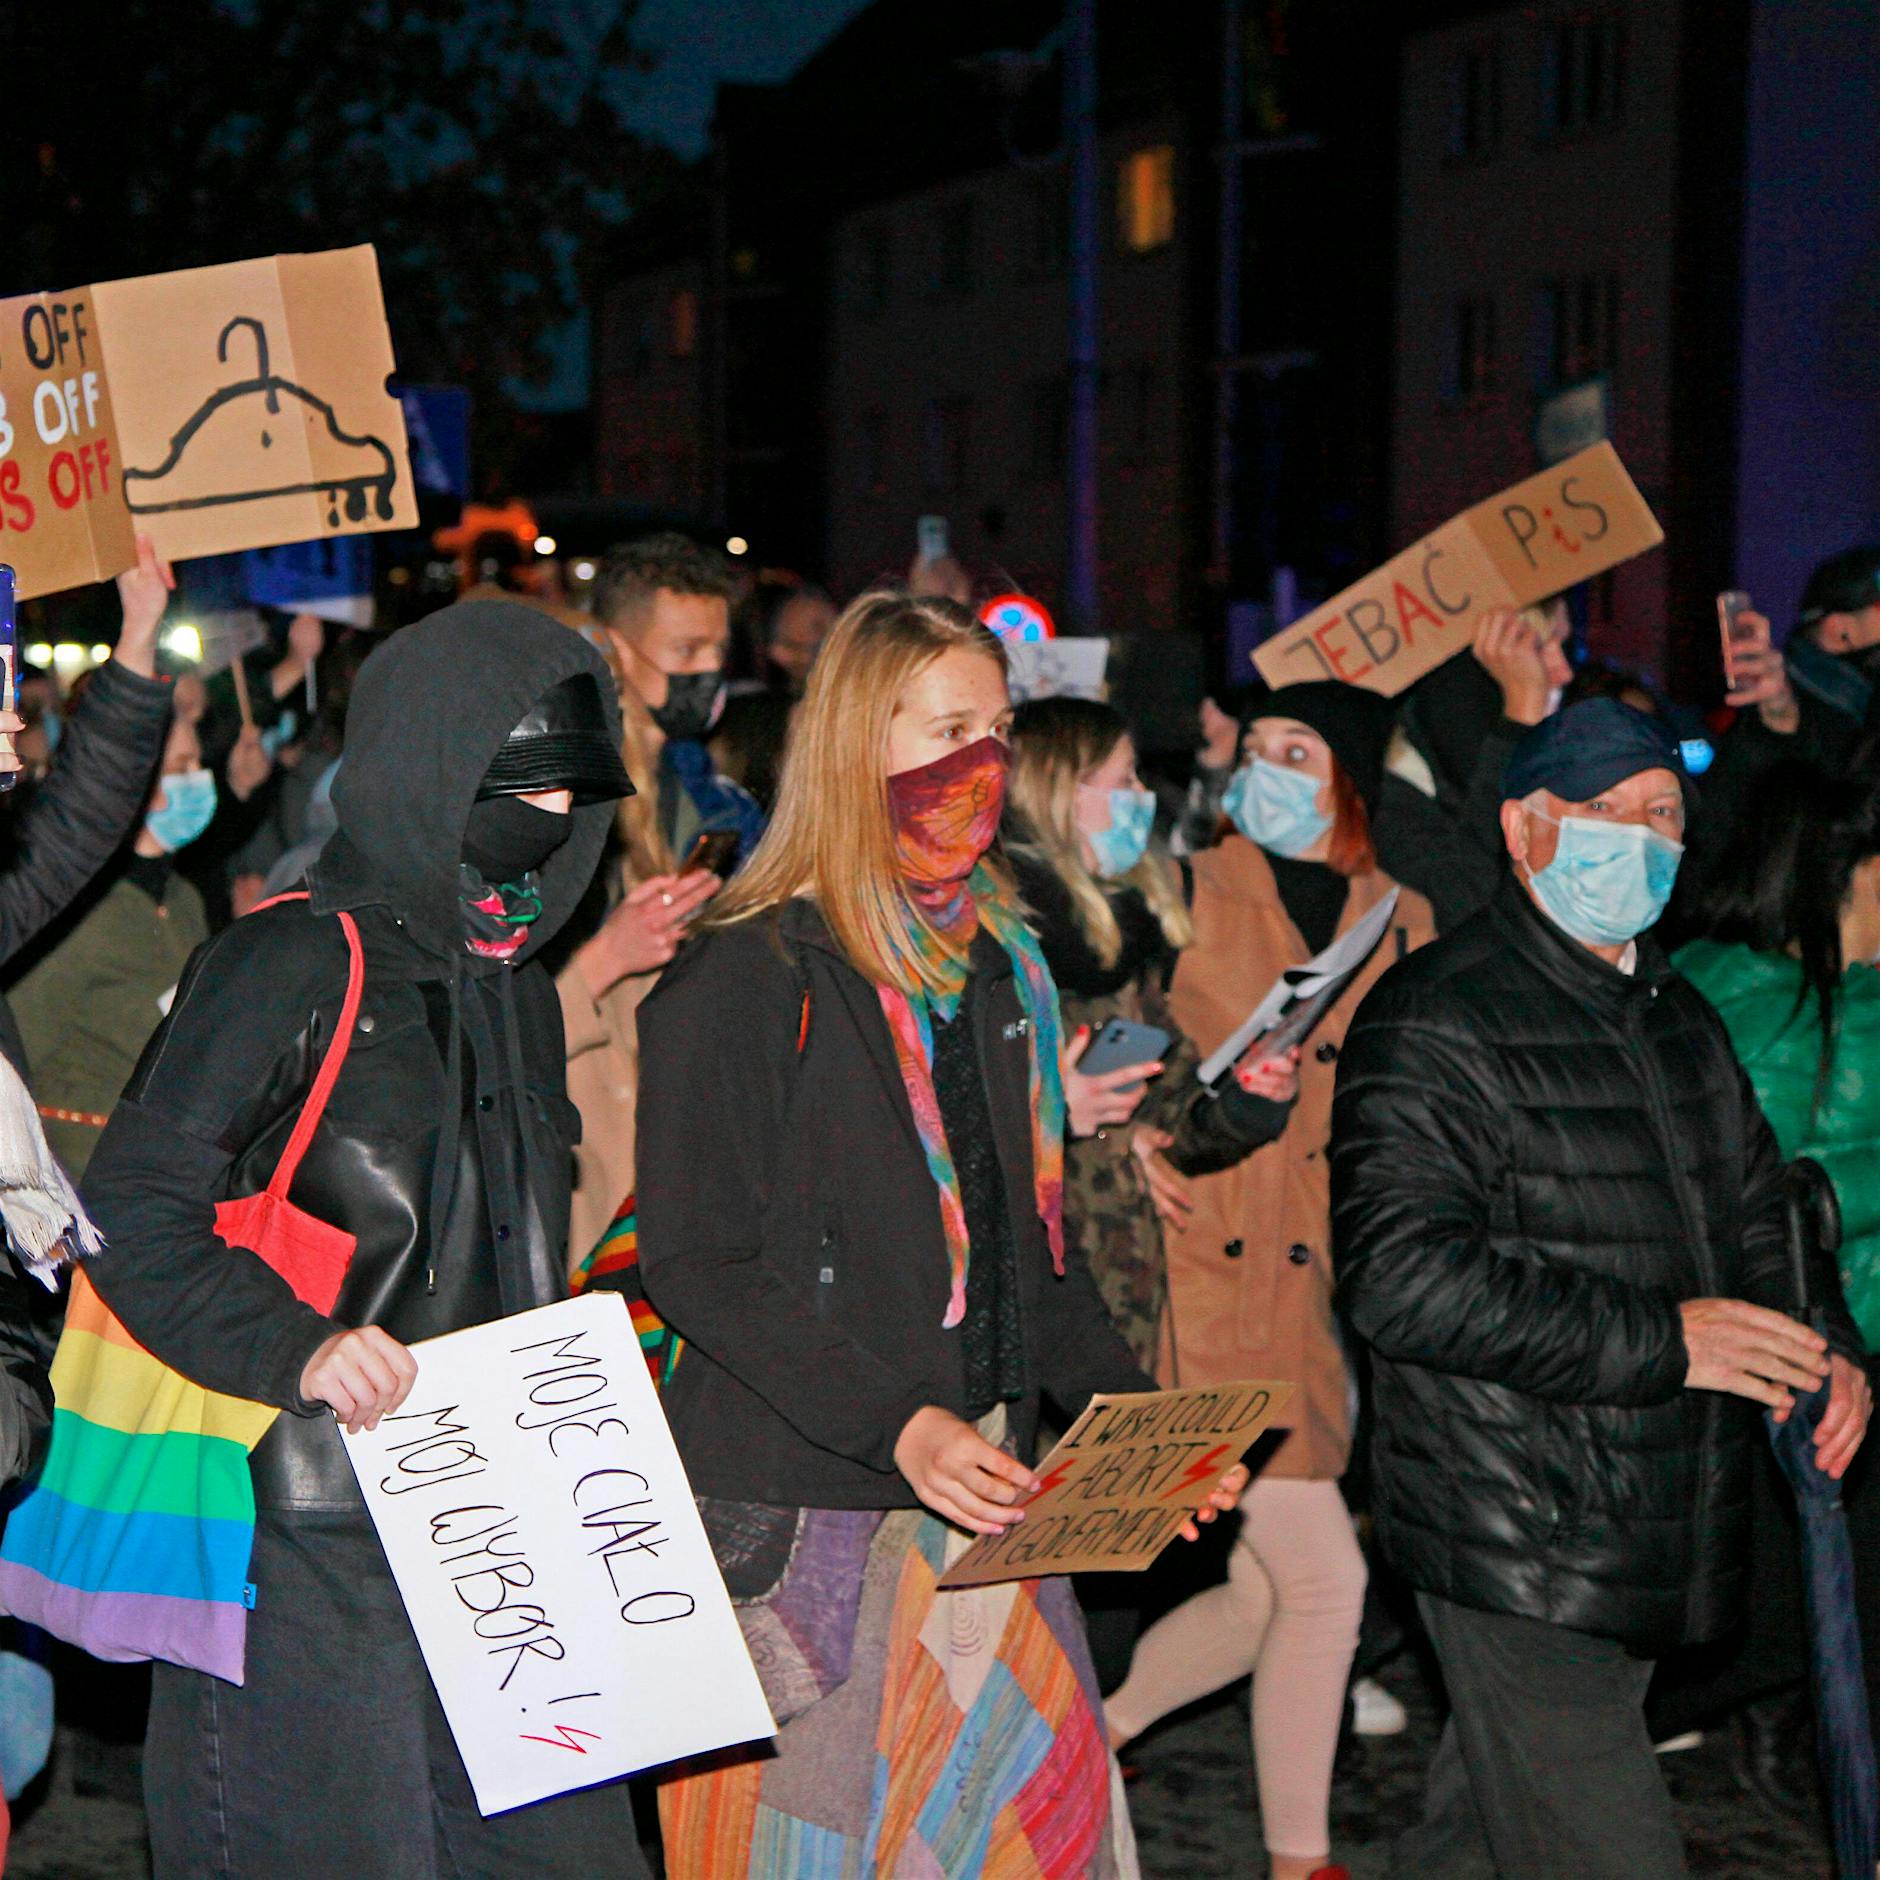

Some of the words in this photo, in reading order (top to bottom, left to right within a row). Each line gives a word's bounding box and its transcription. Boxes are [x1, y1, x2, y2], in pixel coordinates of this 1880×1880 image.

[22, 303, 88, 370] OFF
[33, 371, 100, 445] OFF
[48, 437, 111, 511] OFF
[1064, 1404, 1111, 1449] I
[1168, 1390, 1270, 1434] COULD
[509, 1331, 629, 1457] MOJE
[573, 1468, 696, 1625] CIAŁO
[1056, 1443, 1210, 1502] ABORT
